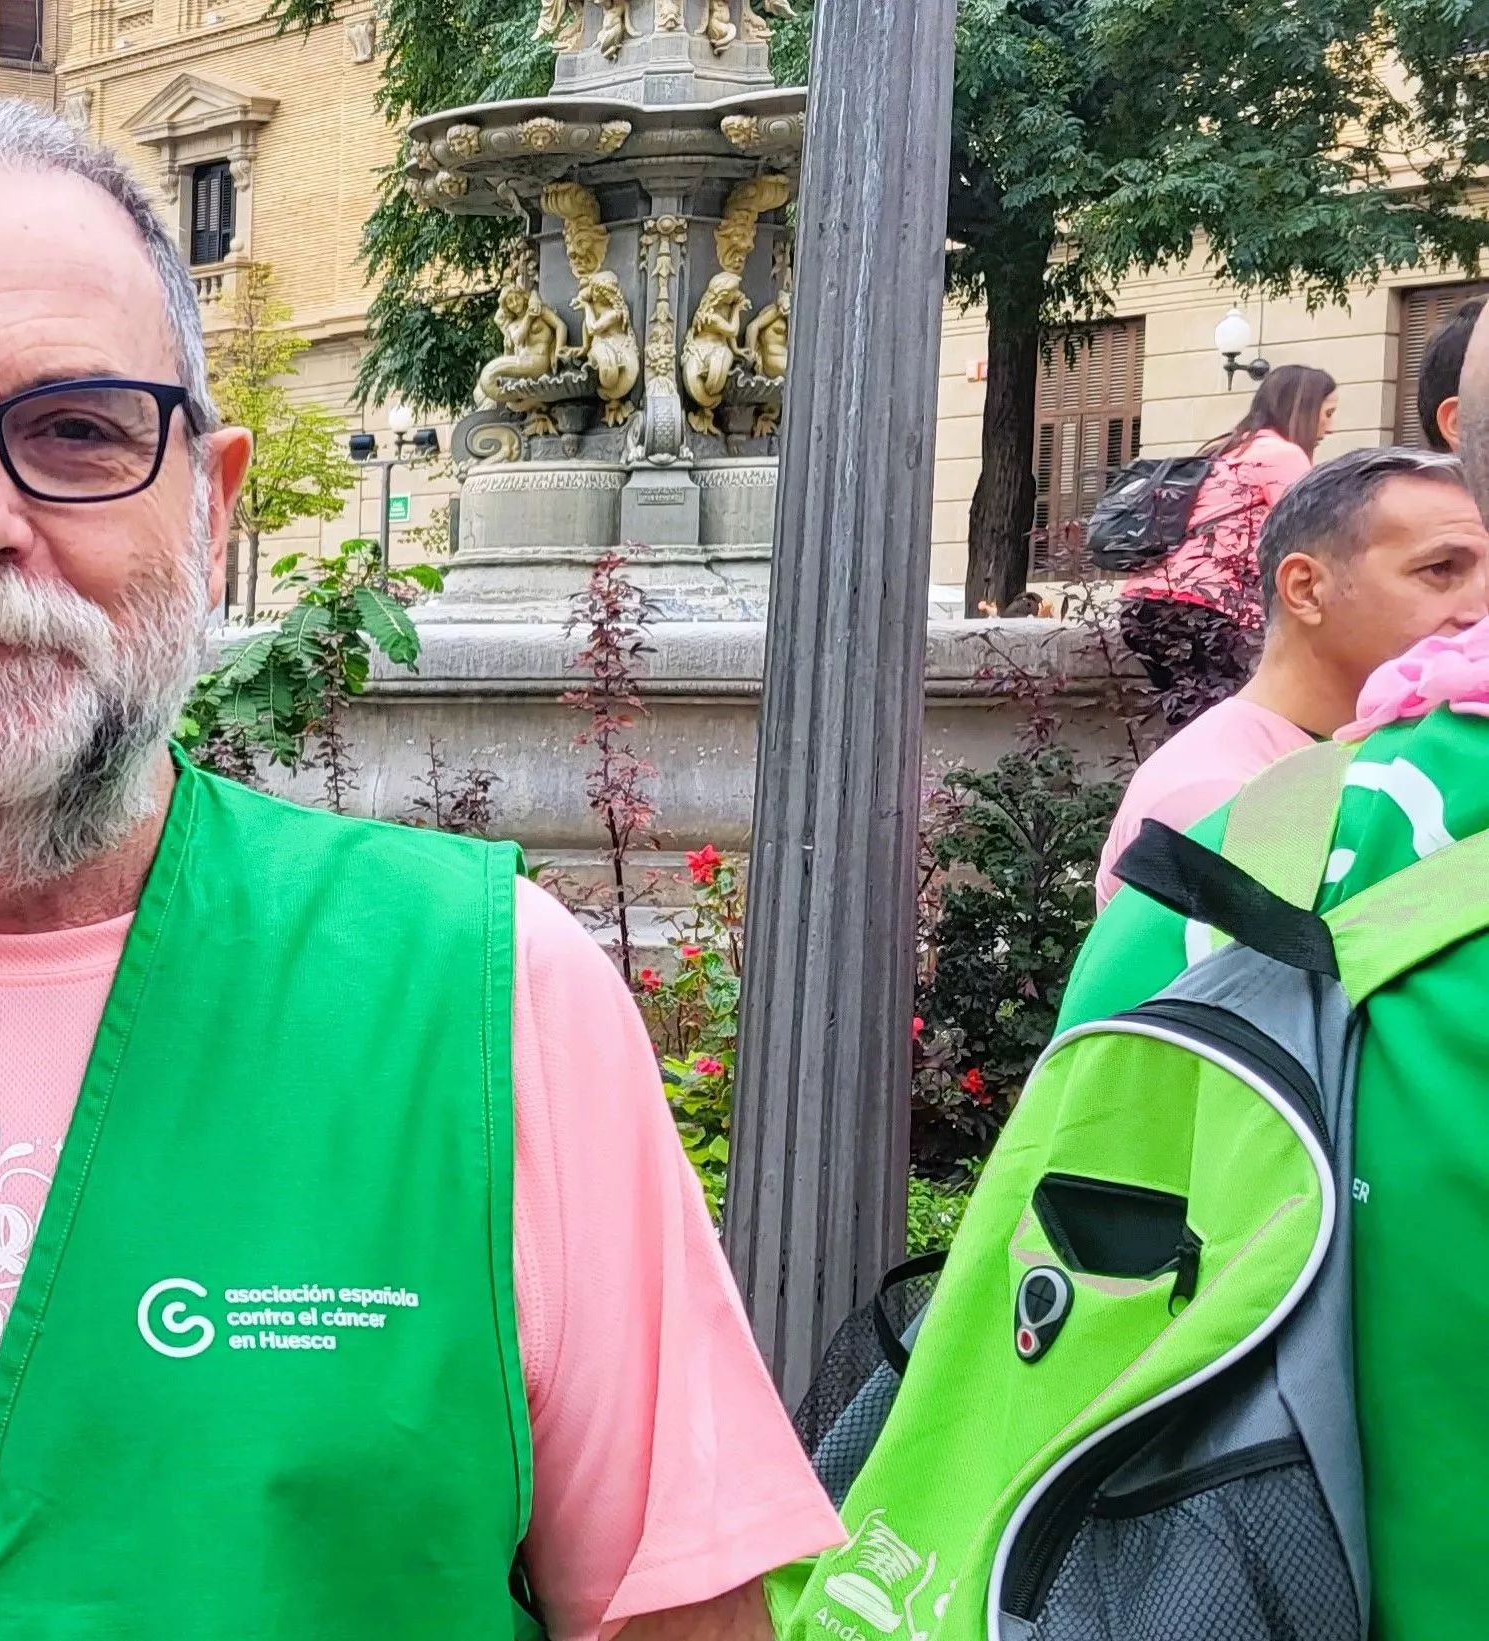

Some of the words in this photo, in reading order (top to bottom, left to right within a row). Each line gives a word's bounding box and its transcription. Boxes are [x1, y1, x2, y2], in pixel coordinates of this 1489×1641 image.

[224, 1284, 336, 1304] asociación
[338, 1286, 419, 1308] española
[226, 1307, 296, 1326] contra
[298, 1307, 318, 1326] el
[321, 1307, 387, 1328] cáncer
[228, 1334, 257, 1349] en
[259, 1330, 337, 1350] Huesca
